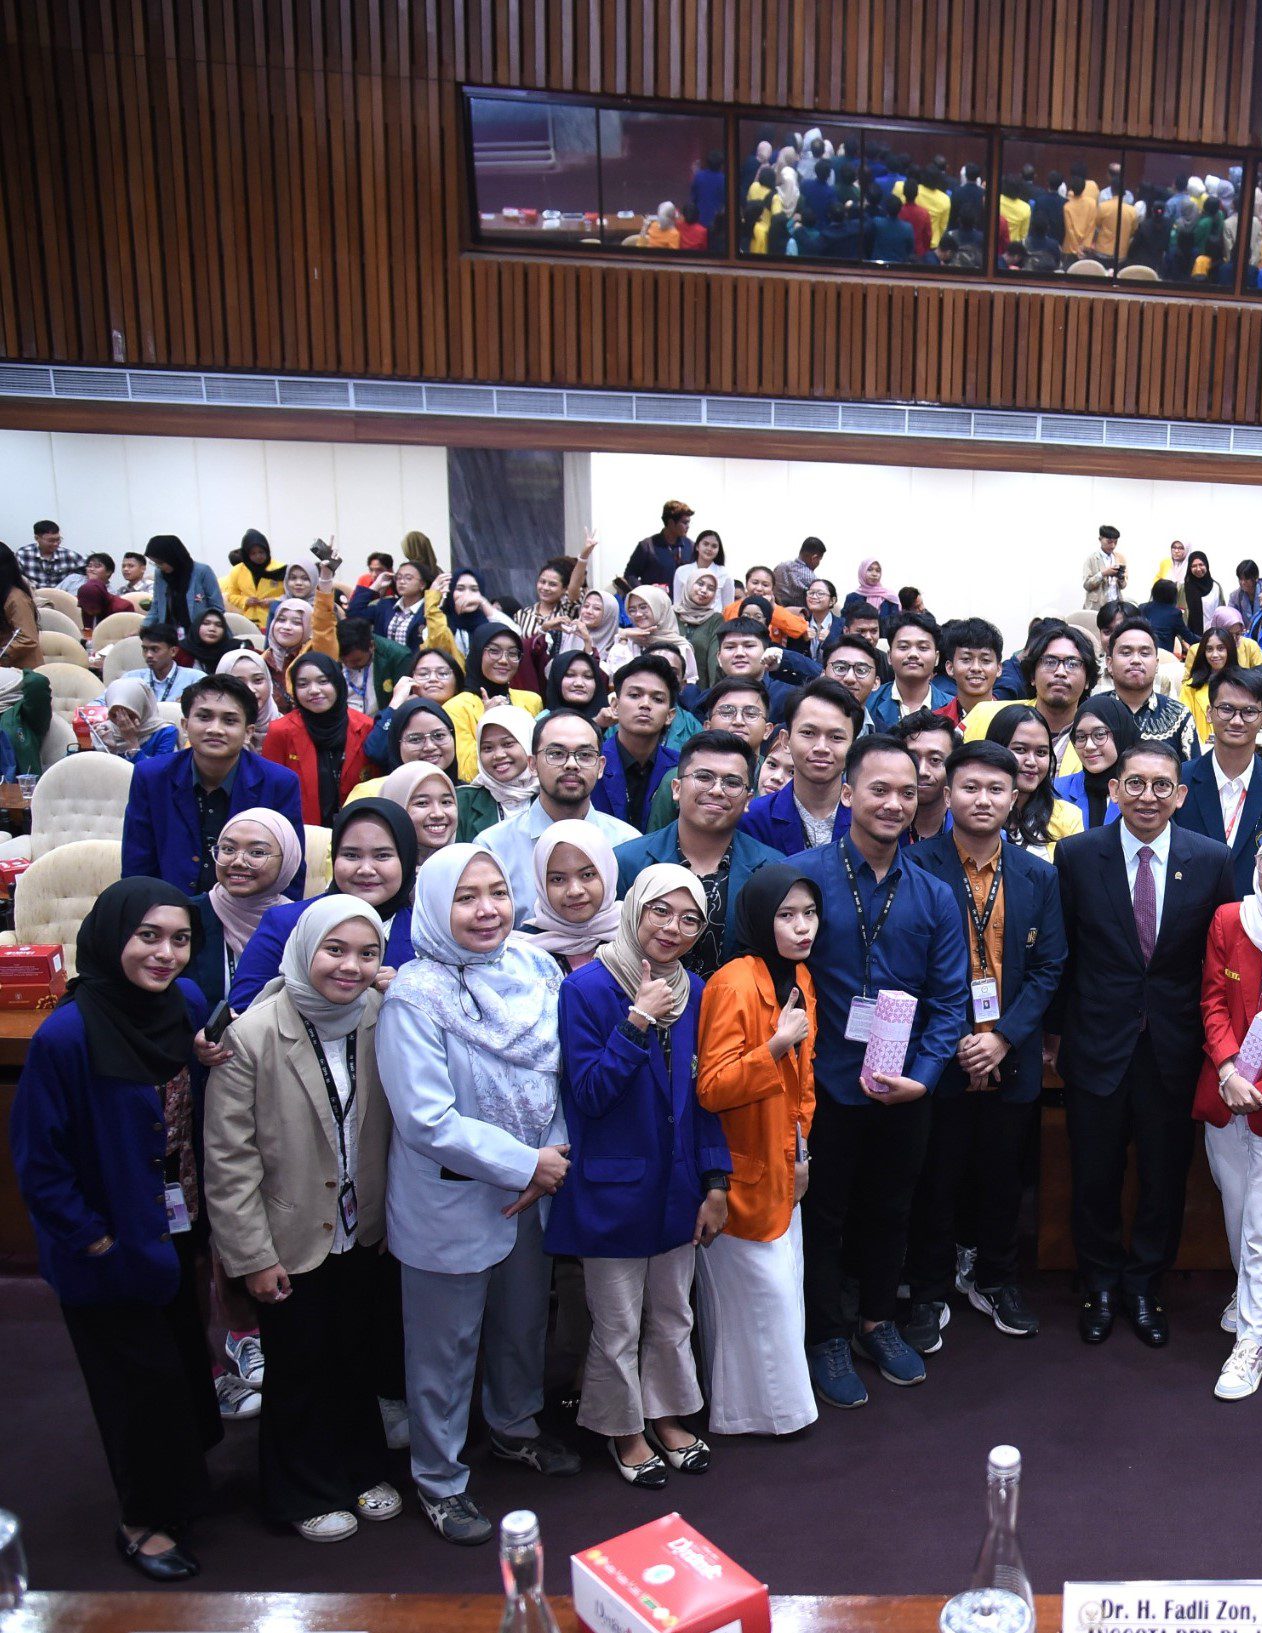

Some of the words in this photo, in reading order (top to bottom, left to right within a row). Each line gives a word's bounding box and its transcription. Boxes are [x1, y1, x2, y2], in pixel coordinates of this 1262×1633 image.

[1101, 1599, 1129, 1620] Dr.
[1137, 1599, 1156, 1620] H.
[1164, 1599, 1209, 1621] Fadli
[1216, 1599, 1257, 1623] Zon,
